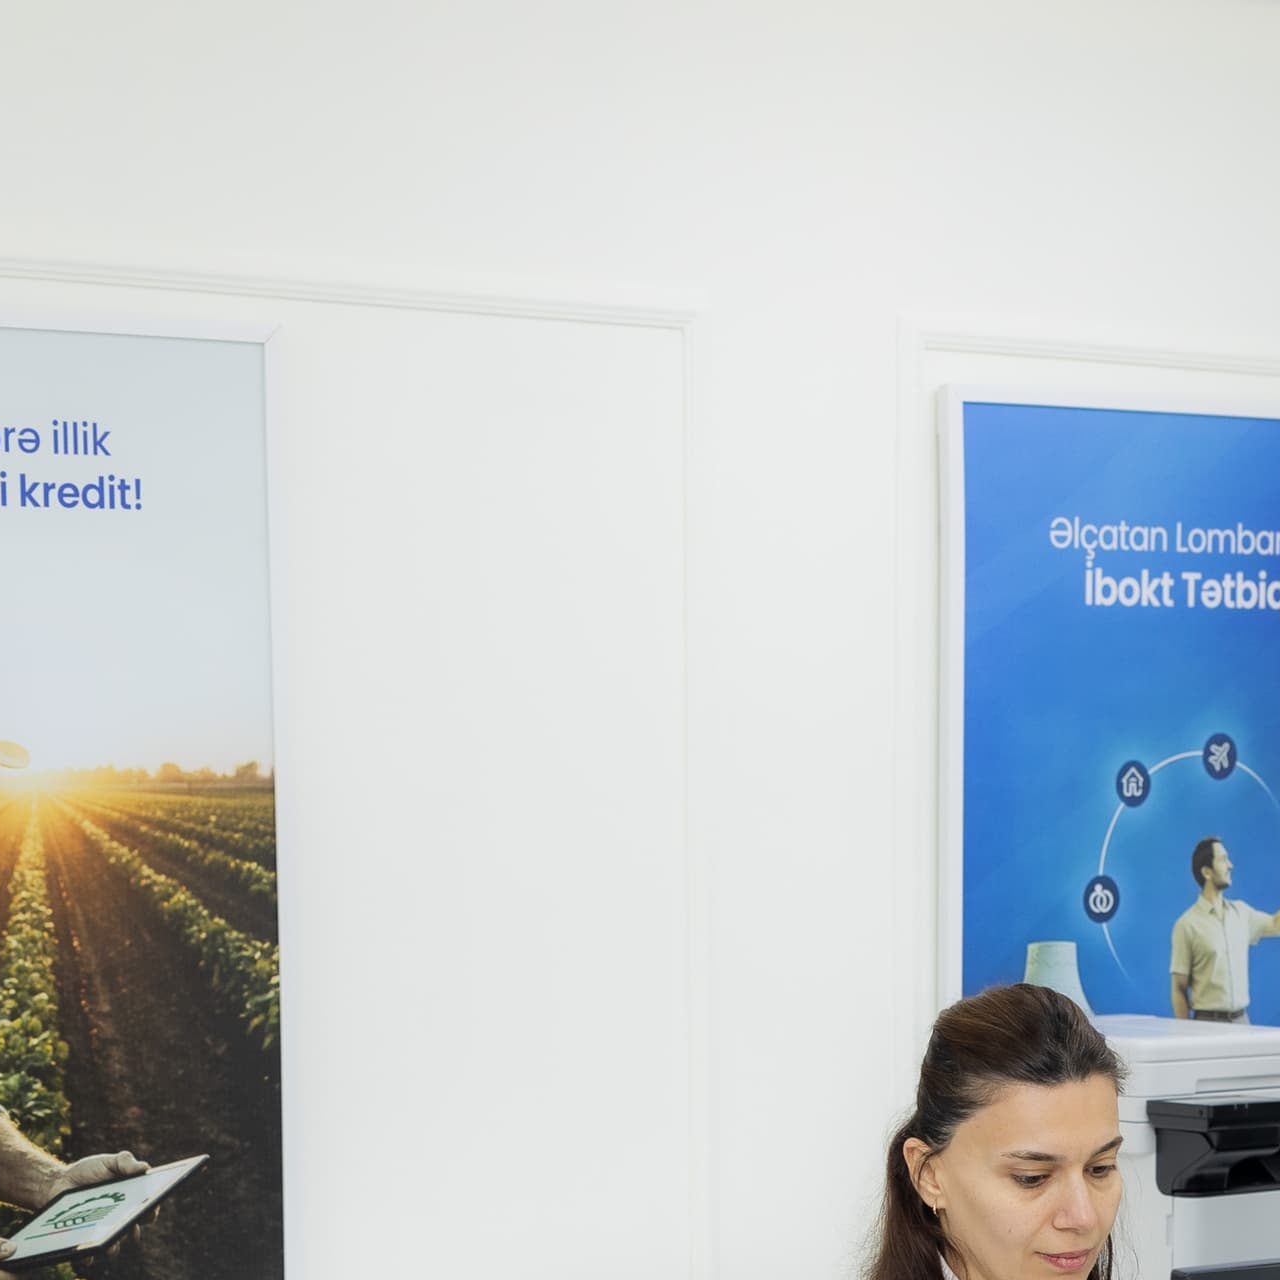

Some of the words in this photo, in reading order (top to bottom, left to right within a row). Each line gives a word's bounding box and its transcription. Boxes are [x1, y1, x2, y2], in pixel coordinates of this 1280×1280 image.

[53, 419, 112, 456] illik
[20, 473, 143, 510] kredit!
[1049, 516, 1168, 560] Əlçatan
[1084, 560, 1174, 608] İbokt
